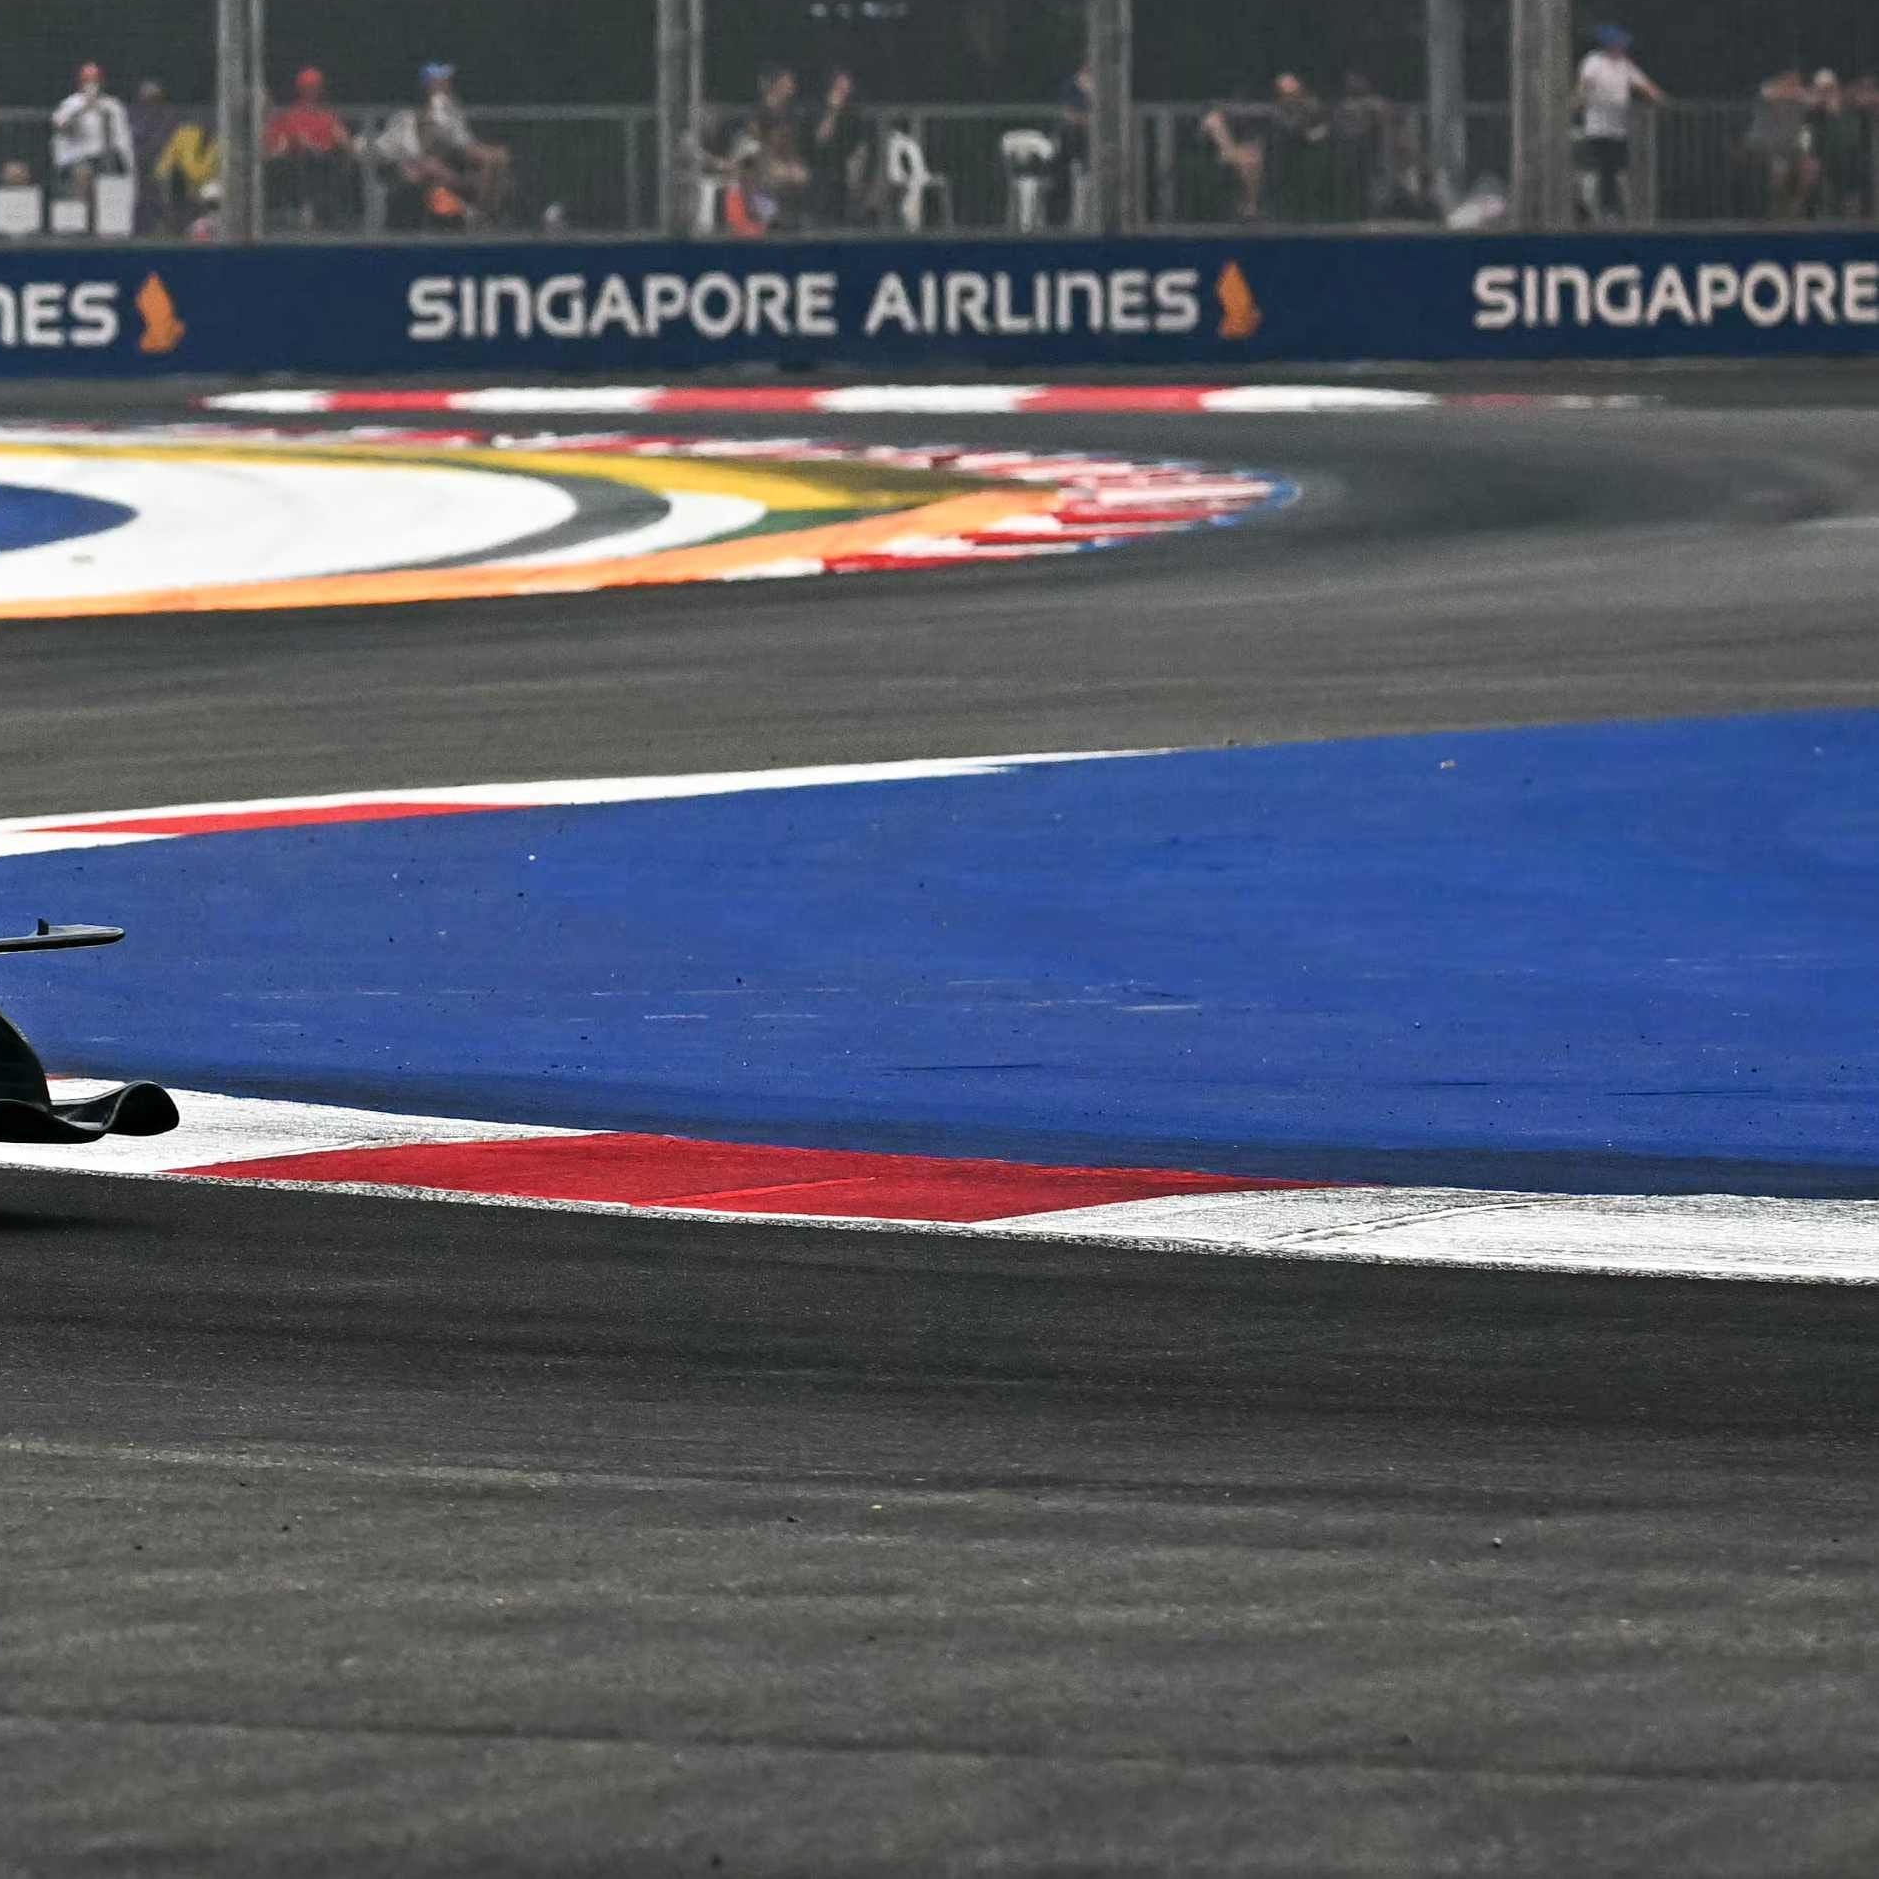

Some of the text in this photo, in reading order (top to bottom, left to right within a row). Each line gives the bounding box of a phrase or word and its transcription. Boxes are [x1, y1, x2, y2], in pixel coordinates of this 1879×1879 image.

[408, 271, 1199, 339] SINGAPORE AIRLINES
[1473, 263, 1879, 329] SINGAPORE
